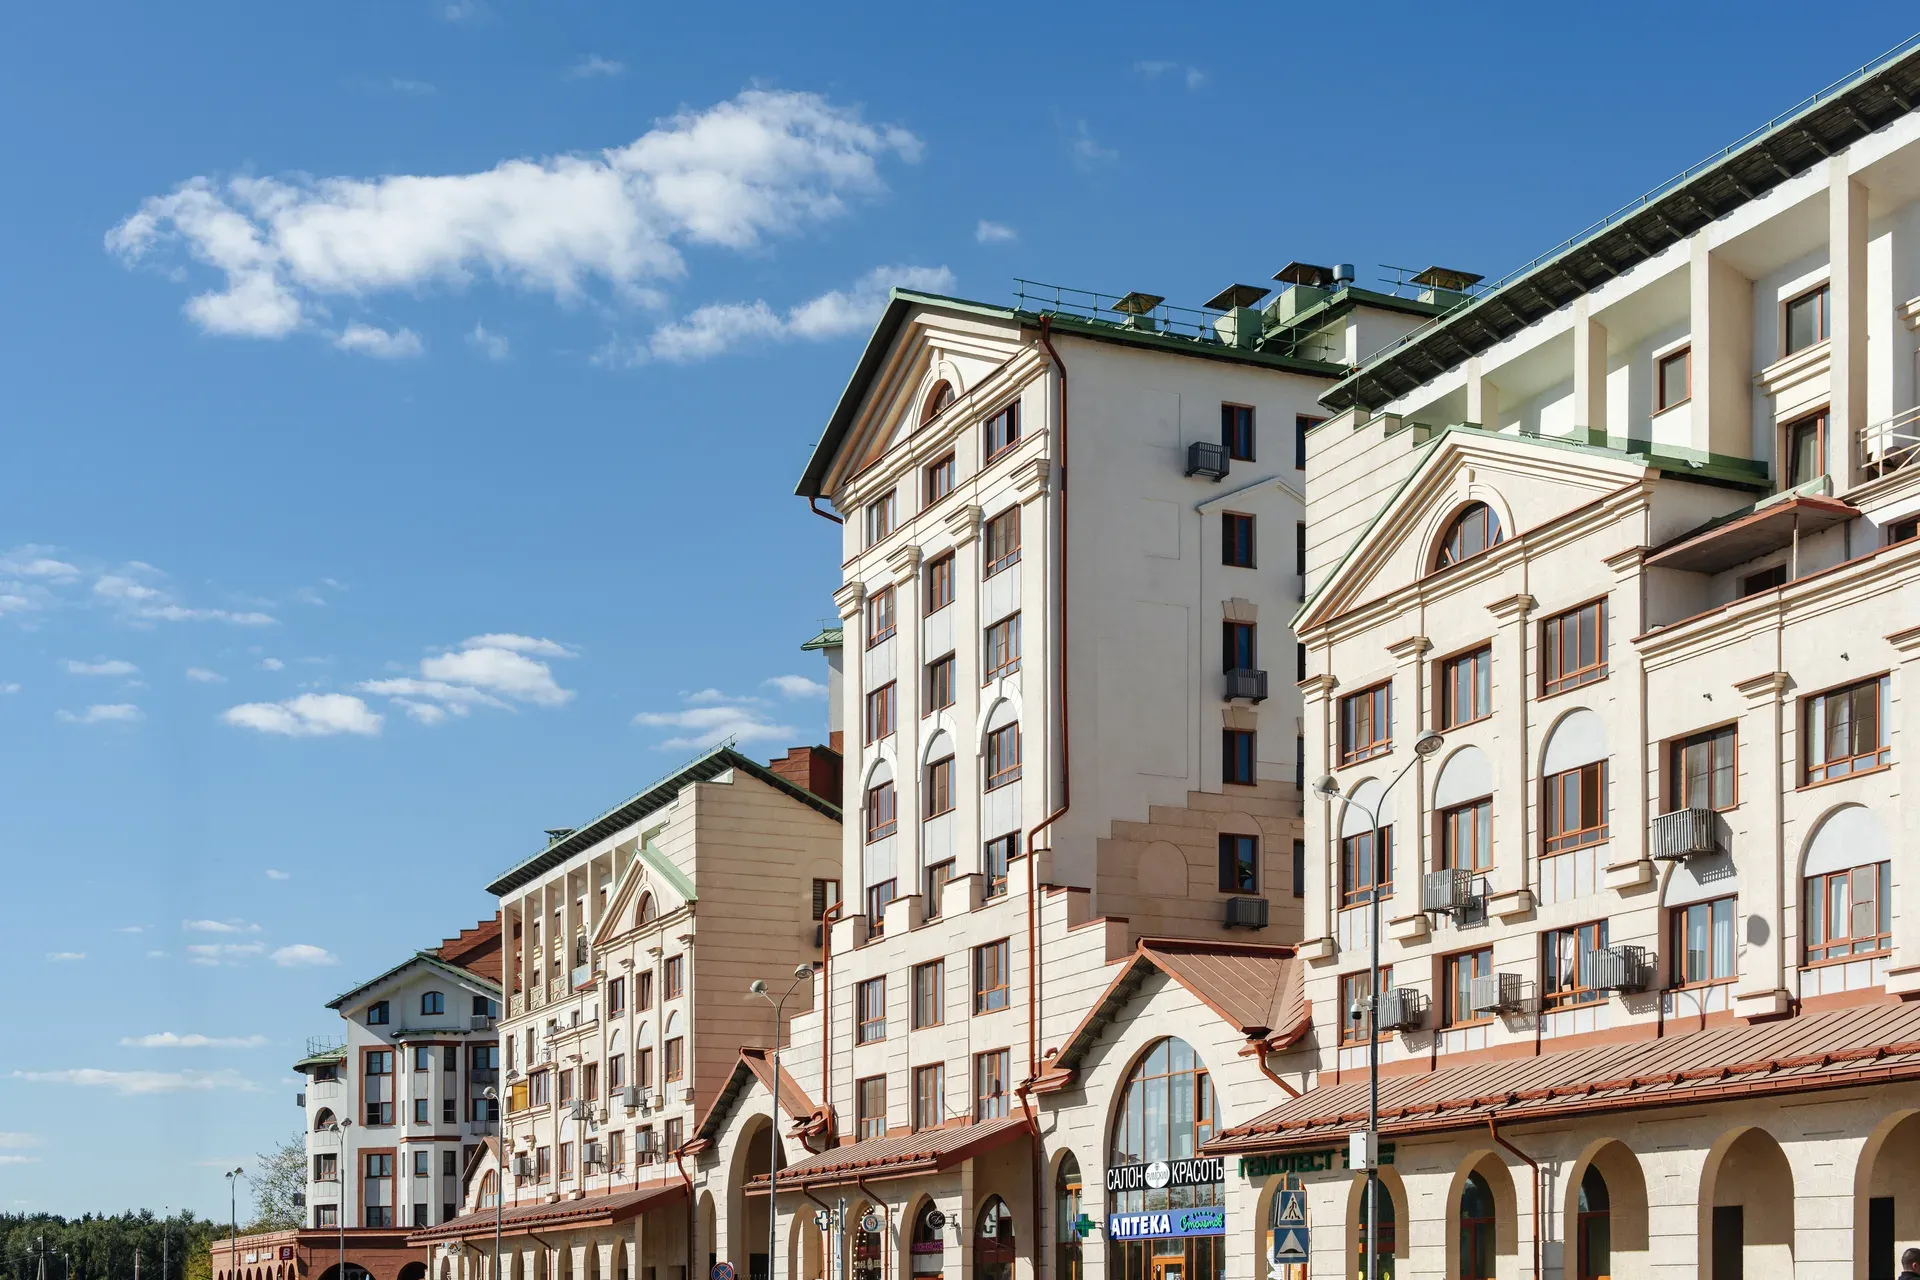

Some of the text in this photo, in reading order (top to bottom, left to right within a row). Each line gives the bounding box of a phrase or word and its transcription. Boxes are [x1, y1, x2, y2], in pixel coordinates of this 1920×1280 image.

[1238, 1151, 1334, 1177] ГЕМОТЕСТ
[1107, 1166, 1144, 1190] САЛОН
[1111, 1214, 1171, 1236] АПТЕКА
